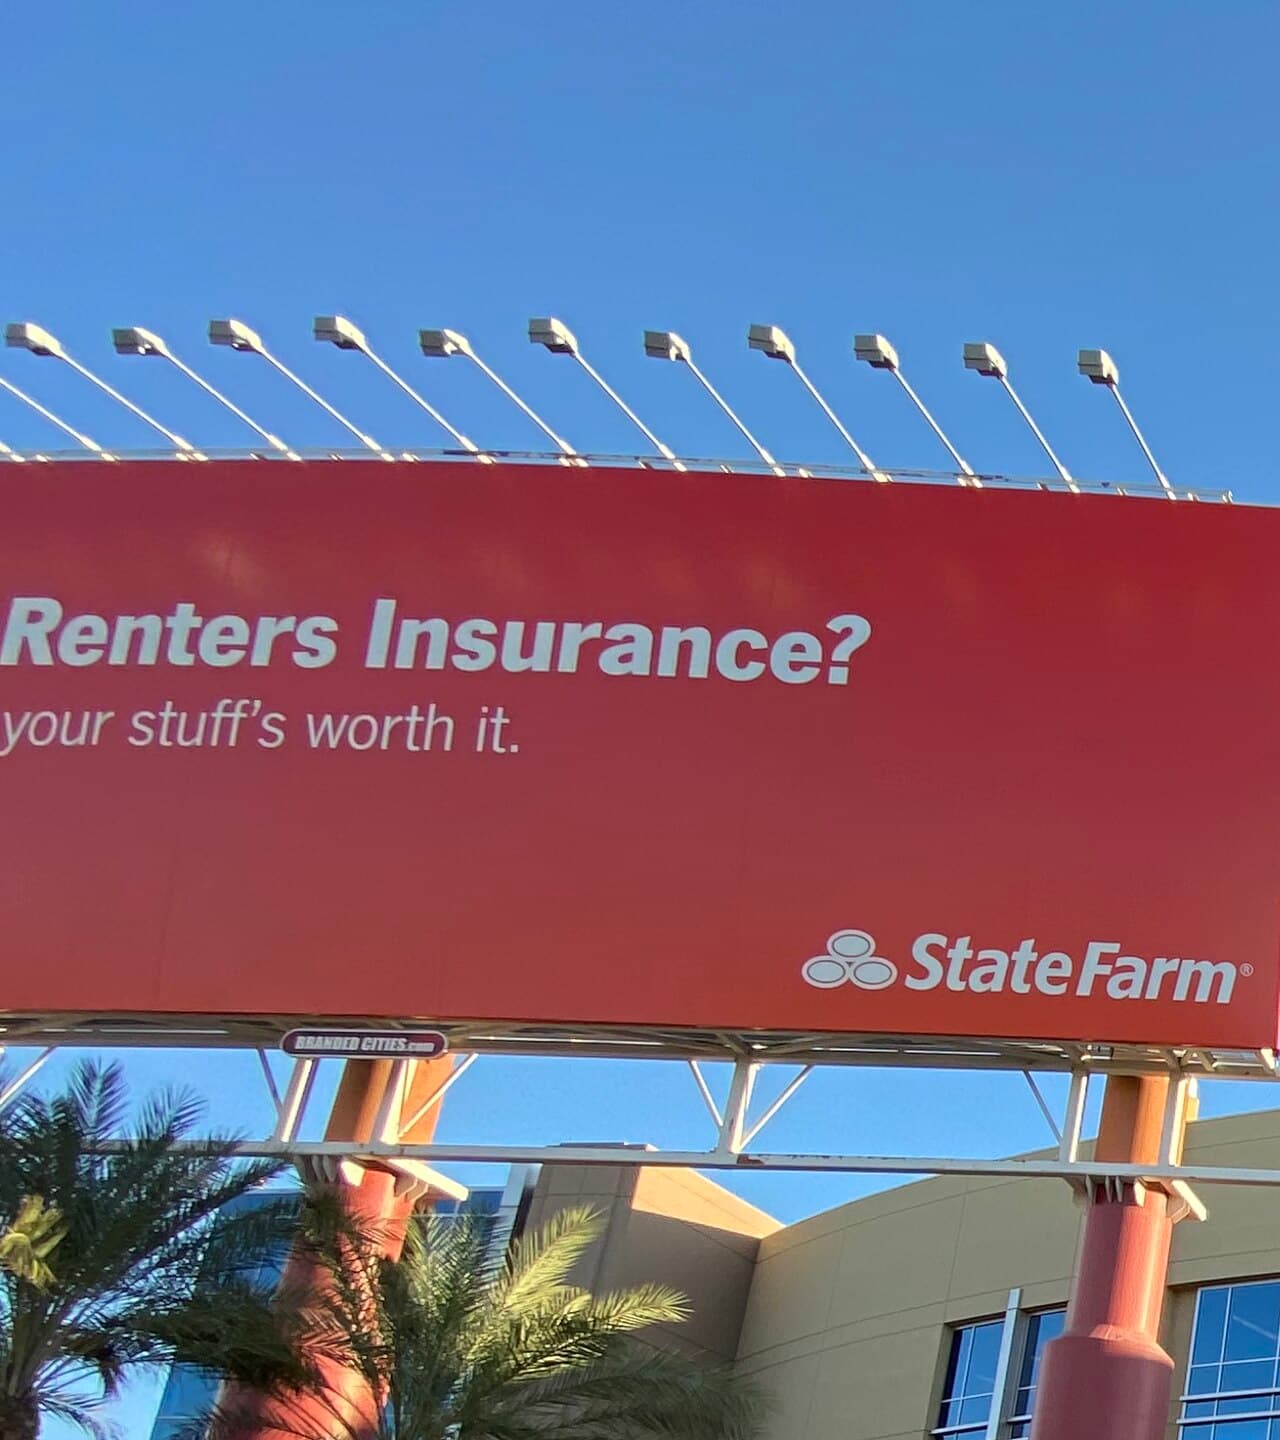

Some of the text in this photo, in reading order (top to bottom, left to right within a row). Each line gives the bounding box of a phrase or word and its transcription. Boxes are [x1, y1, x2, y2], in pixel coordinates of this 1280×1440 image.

[0, 596, 873, 686] Renters Insurance?
[0, 698, 521, 756] your stuff's worth it.
[294, 1035, 360, 1051] BRANDED
